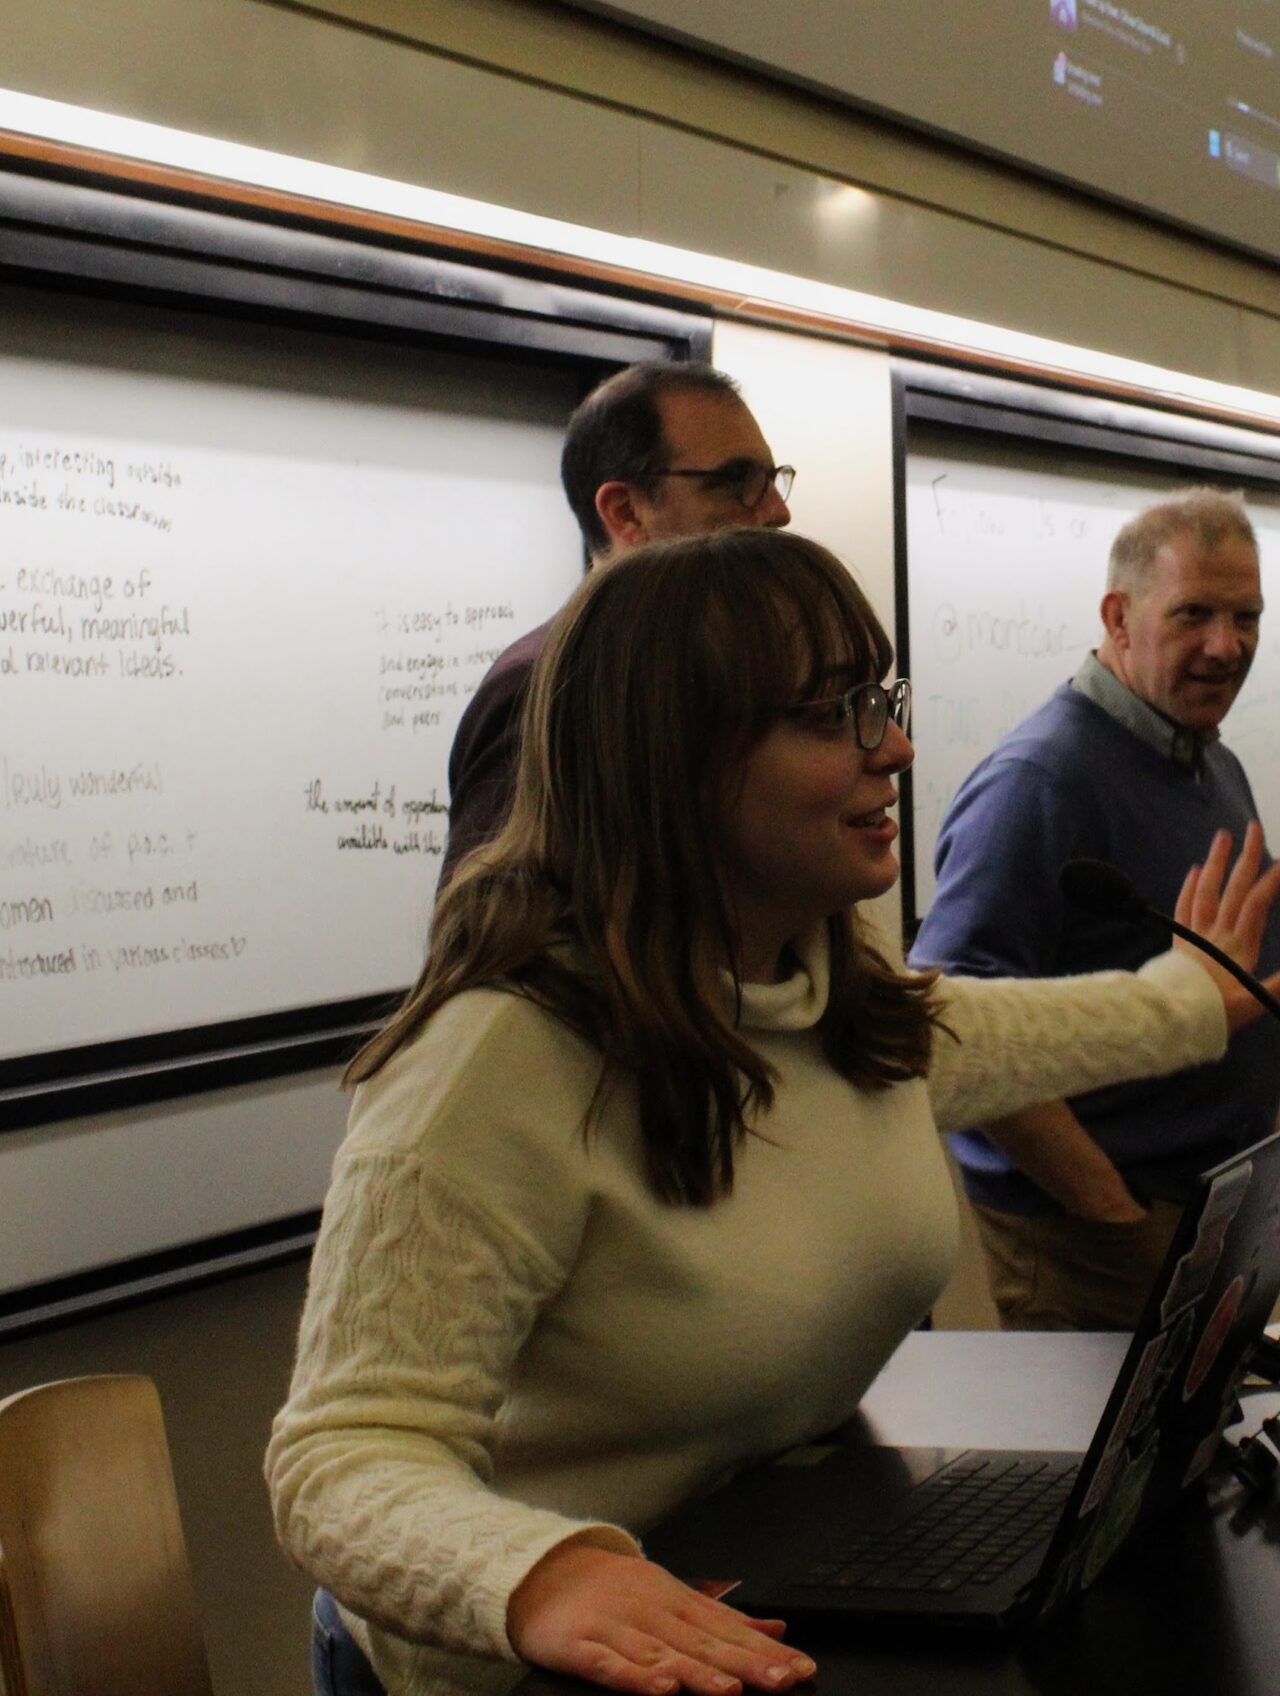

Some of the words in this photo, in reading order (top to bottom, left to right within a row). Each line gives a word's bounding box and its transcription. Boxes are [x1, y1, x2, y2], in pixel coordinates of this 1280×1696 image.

[19, 444, 116, 489] interesting
[57, 482, 87, 514] the
[16, 567, 114, 613] exchange
[122, 568, 152, 599] of
[81, 604, 191, 652] meaningful
[25, 650, 111, 678] relevant
[69, 760, 163, 798] wonderful
[304, 778, 330, 814] the
[162, 880, 199, 905] and
[81, 942, 103, 973] in
